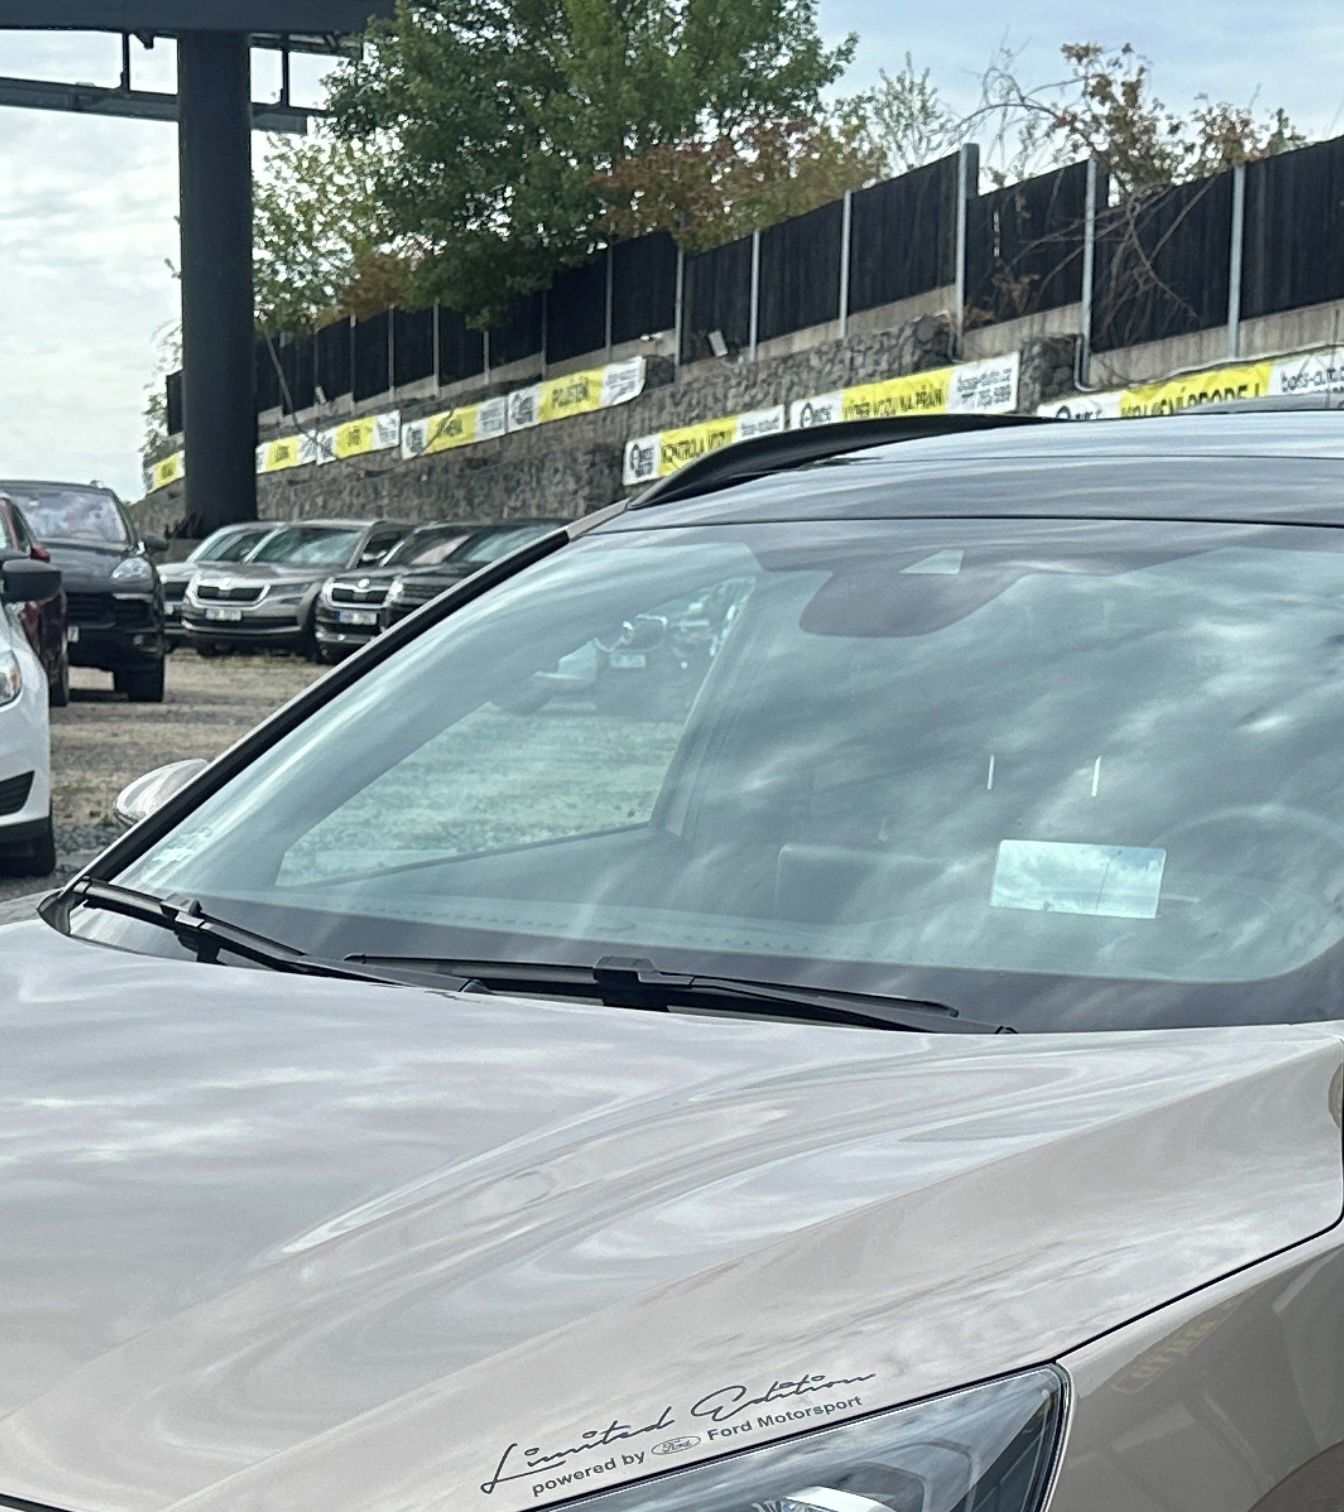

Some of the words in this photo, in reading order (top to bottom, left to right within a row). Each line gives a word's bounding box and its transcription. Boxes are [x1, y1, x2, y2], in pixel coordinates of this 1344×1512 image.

[532, 1457, 617, 1498] powered
[621, 1451, 646, 1466] by
[707, 1421, 753, 1441] Ford
[757, 1395, 864, 1429] Motorsport
